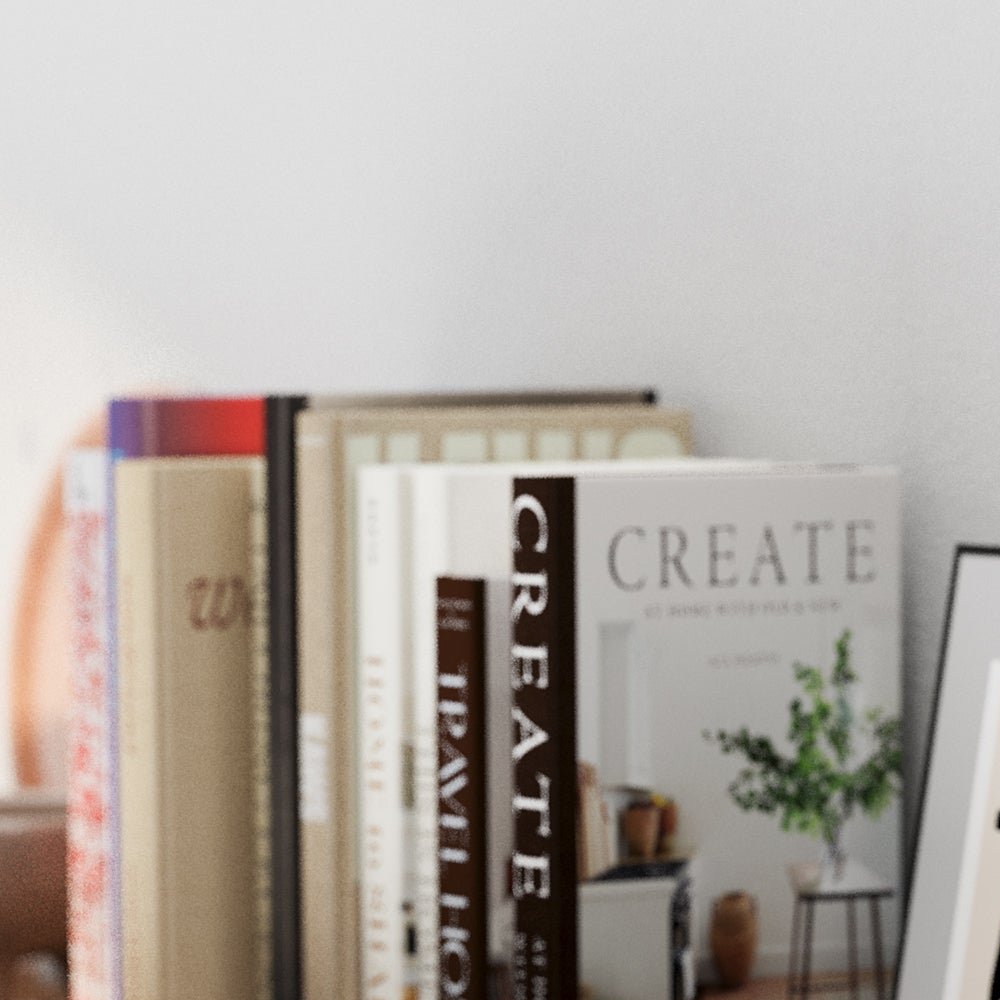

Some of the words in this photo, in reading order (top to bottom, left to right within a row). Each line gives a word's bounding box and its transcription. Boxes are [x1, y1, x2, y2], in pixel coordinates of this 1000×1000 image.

[606, 518, 878, 593] CREATE
[436, 661, 470, 879] TRAVEL
[511, 493, 551, 899] CREATE
